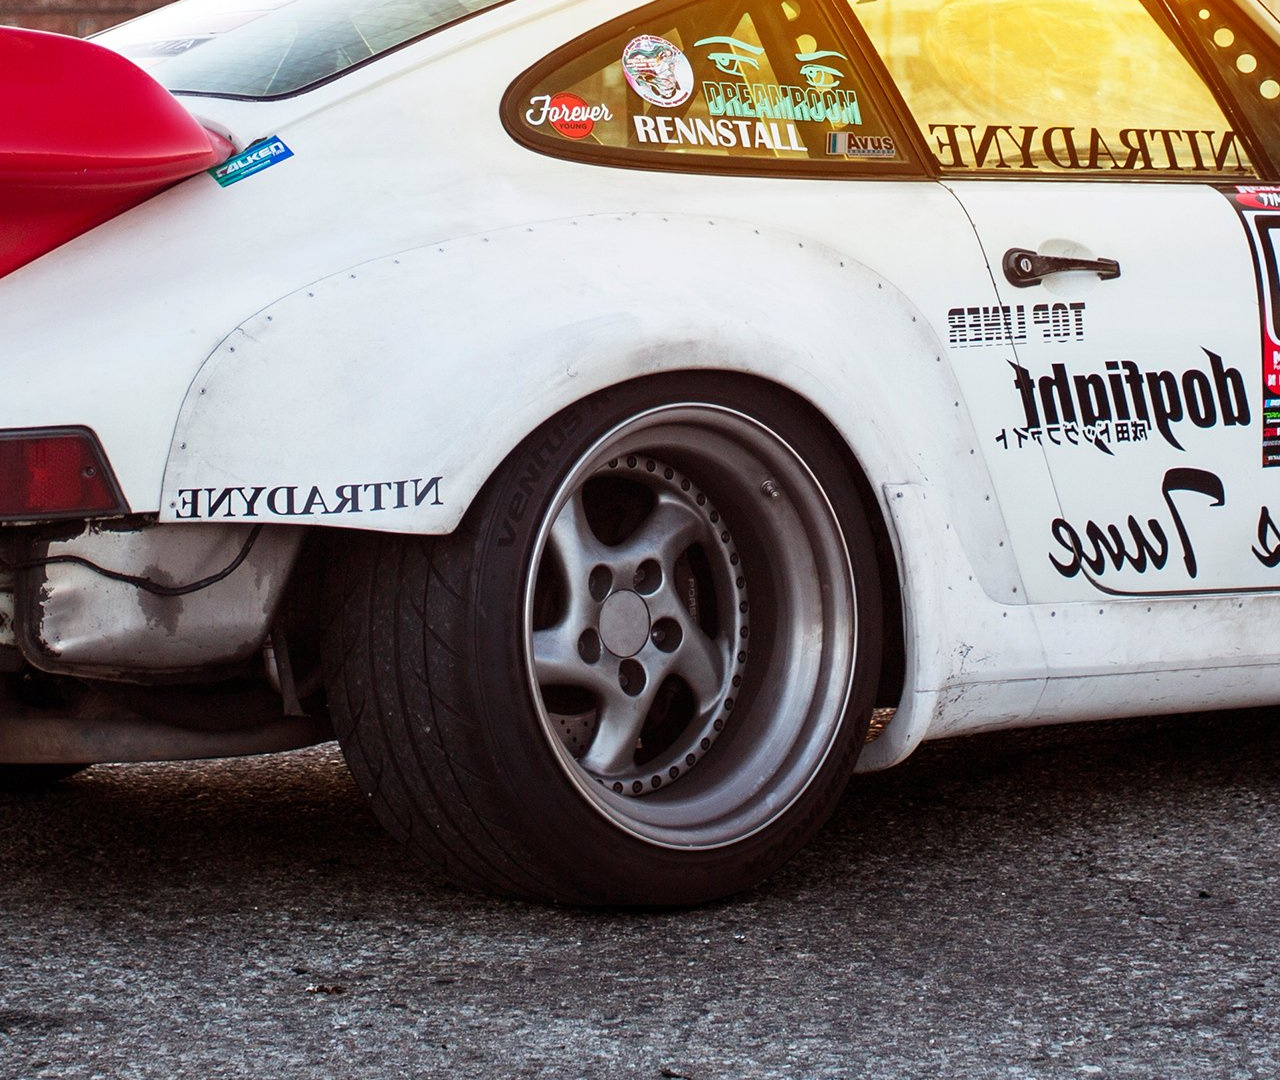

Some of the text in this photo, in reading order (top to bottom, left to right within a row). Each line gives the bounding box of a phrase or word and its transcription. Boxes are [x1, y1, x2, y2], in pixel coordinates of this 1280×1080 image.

[525, 94, 613, 126] Forever
[702, 81, 863, 125] DREAMROOM
[559, 122, 587, 130] YOUNG
[633, 115, 808, 151] RENNSTALL
[848, 133, 894, 149] Avus
[216, 142, 285, 177] FALKEN
